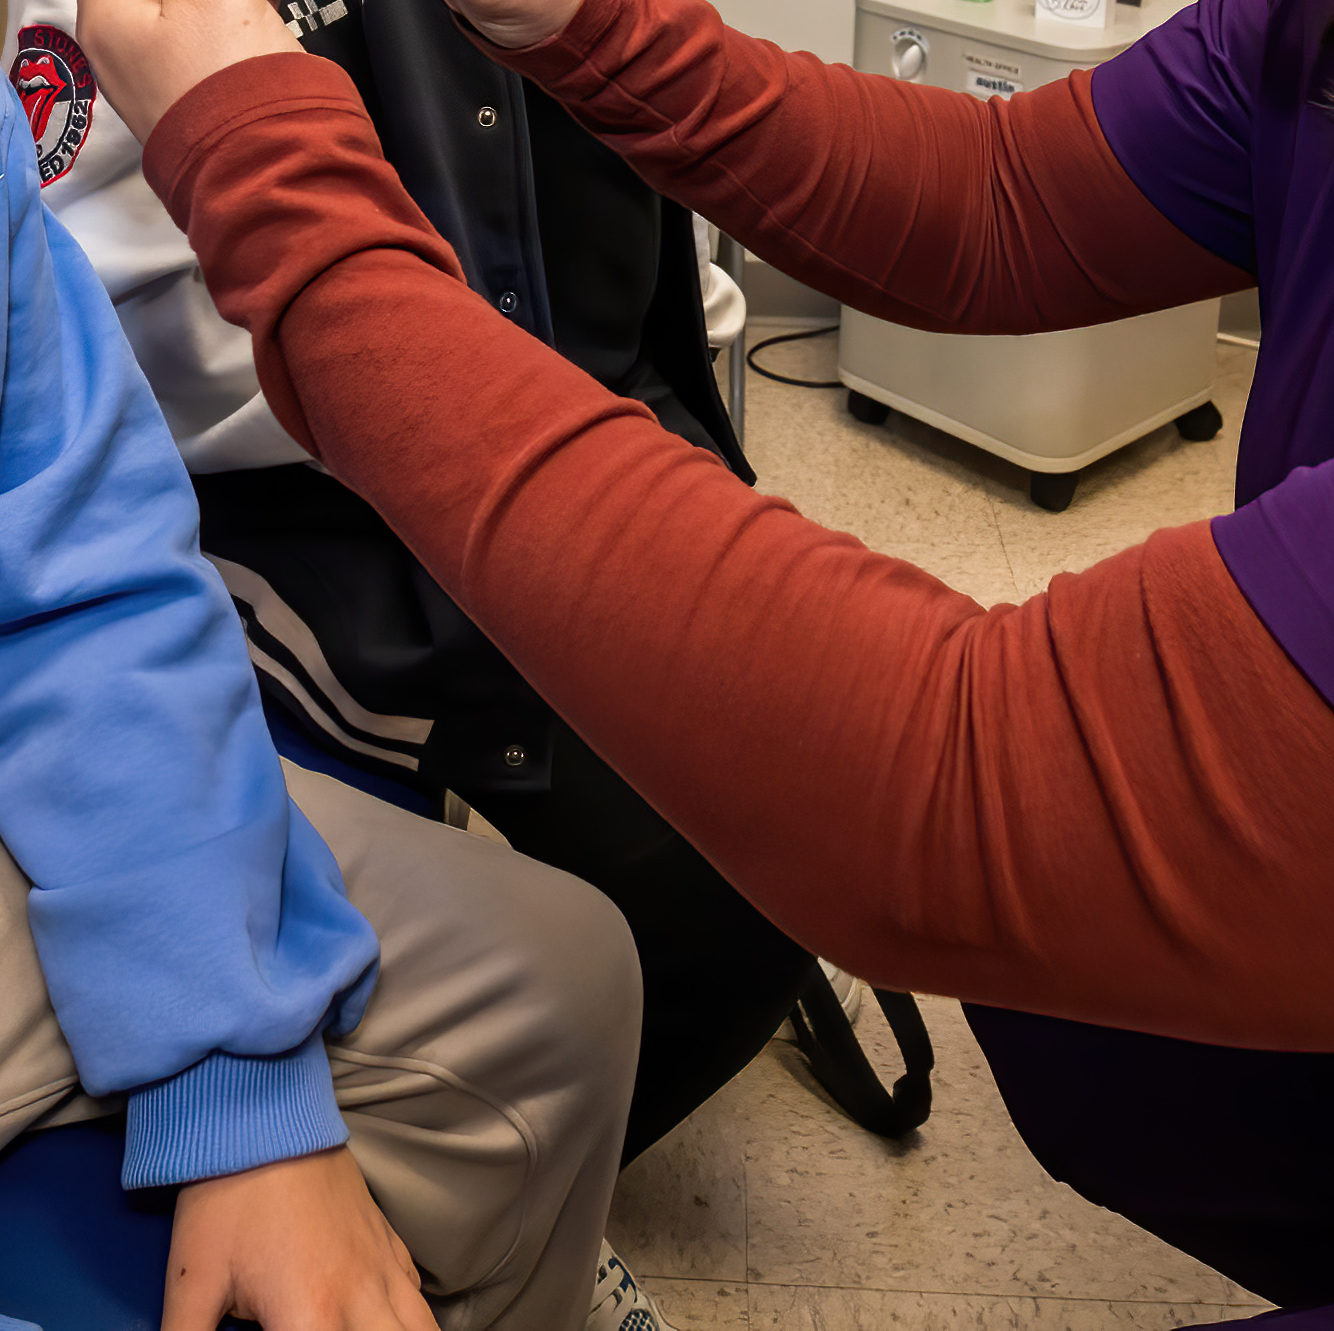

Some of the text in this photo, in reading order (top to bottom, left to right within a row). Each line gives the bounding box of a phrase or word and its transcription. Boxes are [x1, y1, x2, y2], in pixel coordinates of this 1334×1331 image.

[34, 29, 92, 88] STONES
[39, 100, 89, 183] ED 1962
